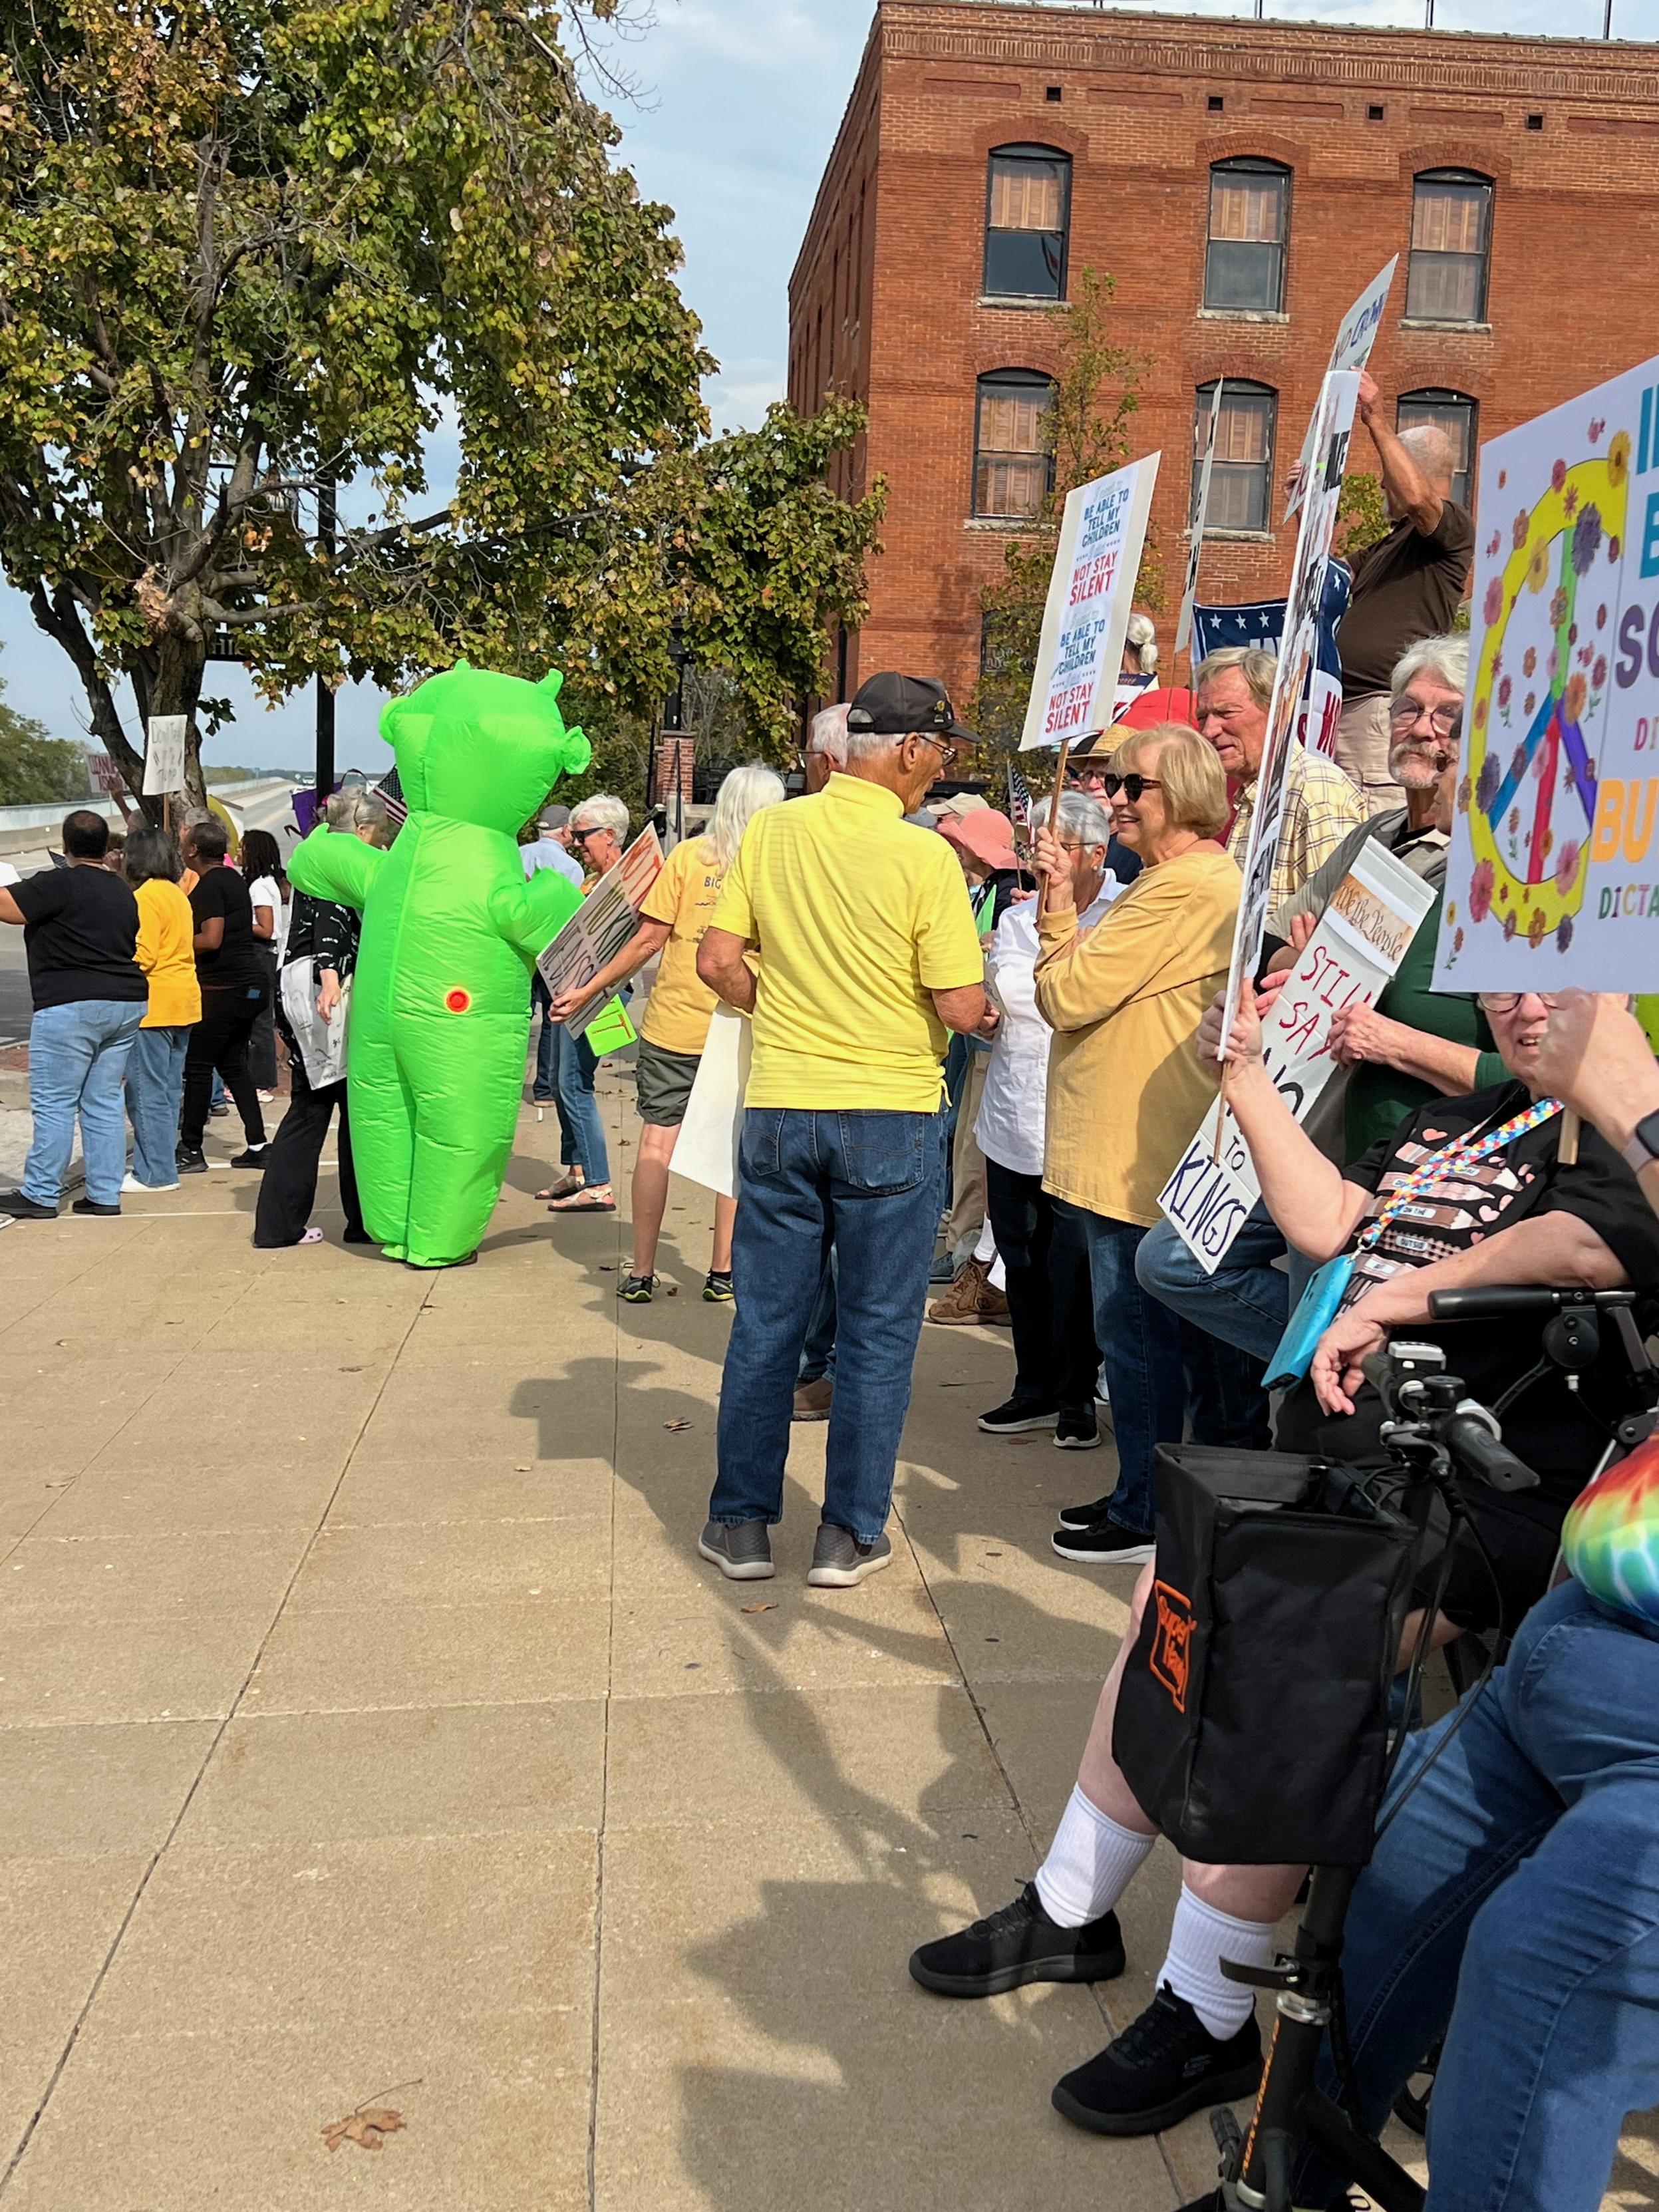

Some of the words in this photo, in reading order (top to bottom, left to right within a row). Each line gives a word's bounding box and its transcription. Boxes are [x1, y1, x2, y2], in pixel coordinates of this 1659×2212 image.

[1636, 383, 1659, 476] I
[1084, 505, 1094, 521] BE
[1096, 494, 1116, 514] ABLE
[1119, 488, 1130, 504] TO
[1088, 513, 1104, 532] TELL
[1107, 506, 1120, 522] MY
[1082, 519, 1120, 548] CHILDREN
[1073, 562, 1092, 584] NOT
[1094, 550, 1119, 573] STAY
[1070, 569, 1114, 606] SILENT
[1060, 632, 1071, 647] BE
[1072, 623, 1091, 643] ABLE
[1094, 619, 1105, 634] TO
[1065, 642, 1079, 659] TELL
[1083, 635, 1096, 652] MY
[1059, 650, 1096, 675] CHILDREN
[1049, 691, 1068, 711] NOT
[1070, 682, 1094, 703] STAY
[1046, 701, 1090, 733] SILENT
[619, 834, 653, 881] NO
[704, 876, 722, 889] BIG
[583, 884, 625, 935] NO
[1336, 883, 1357, 916] We
[1363, 909, 1404, 962] People
[1225, 1135, 1245, 1171] TO
[1160, 1140, 1247, 1257] KINGS
